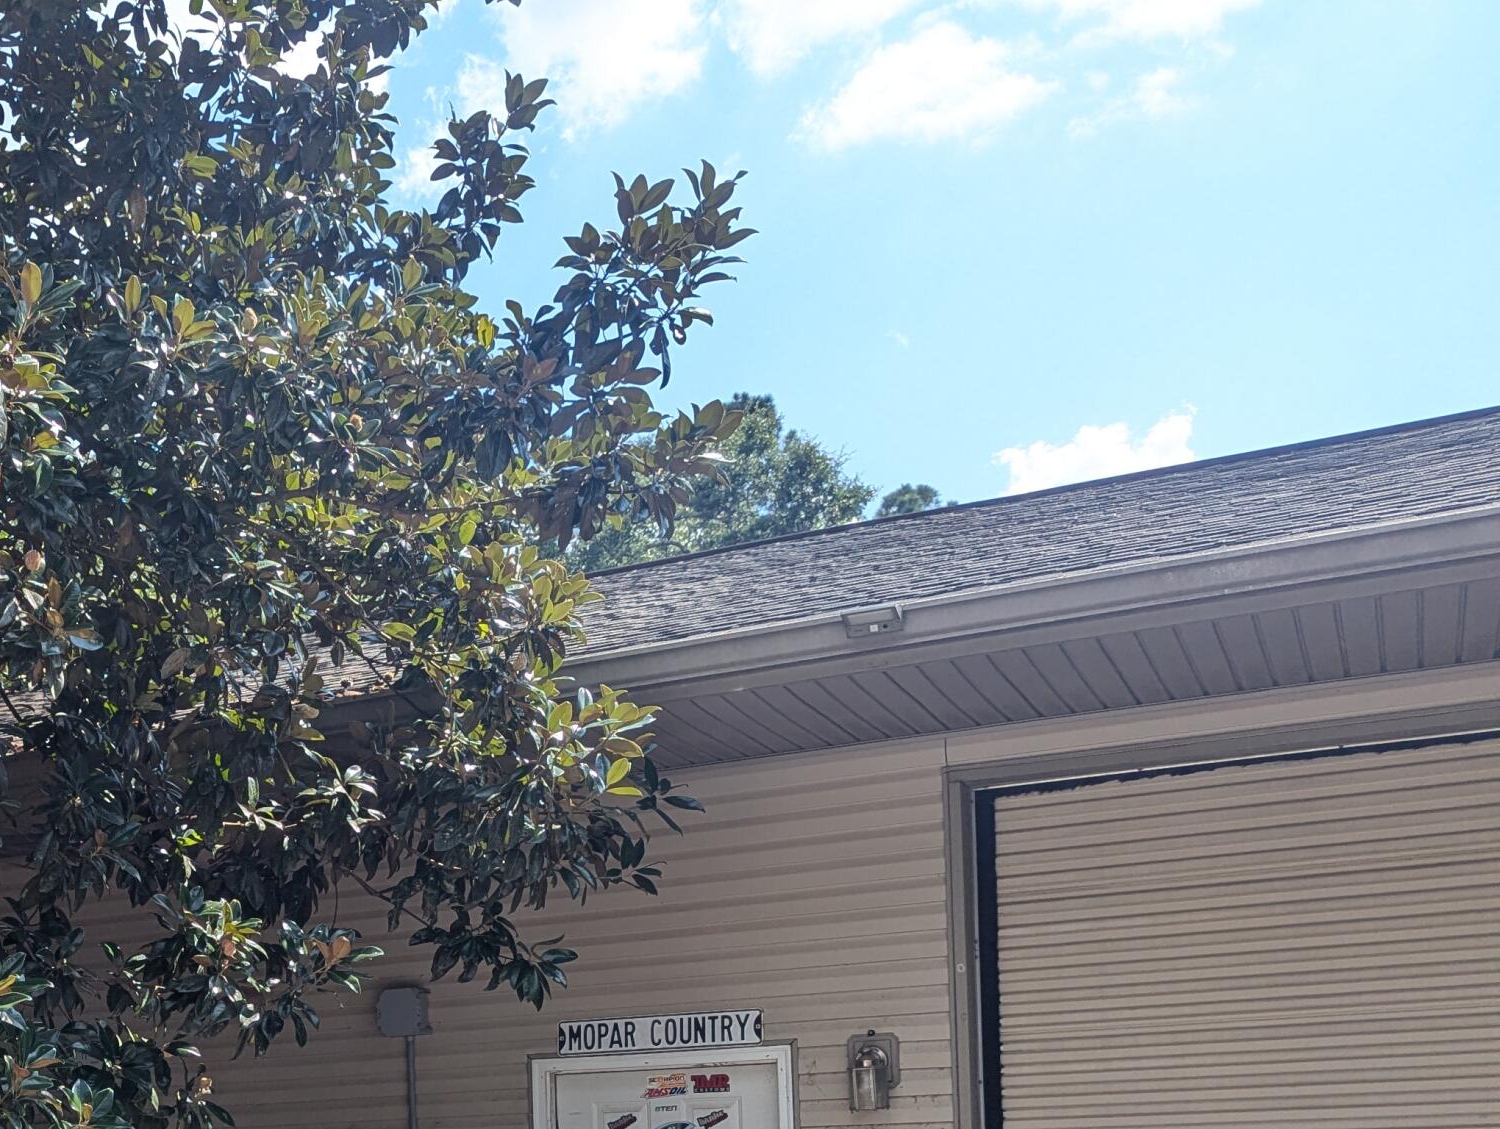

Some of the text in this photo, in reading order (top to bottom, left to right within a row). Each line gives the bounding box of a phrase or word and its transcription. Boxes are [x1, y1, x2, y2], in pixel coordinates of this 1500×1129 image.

[568, 1014, 751, 1052] MOPAR COUNTRY
[645, 1087, 687, 1098] AMSOIL
